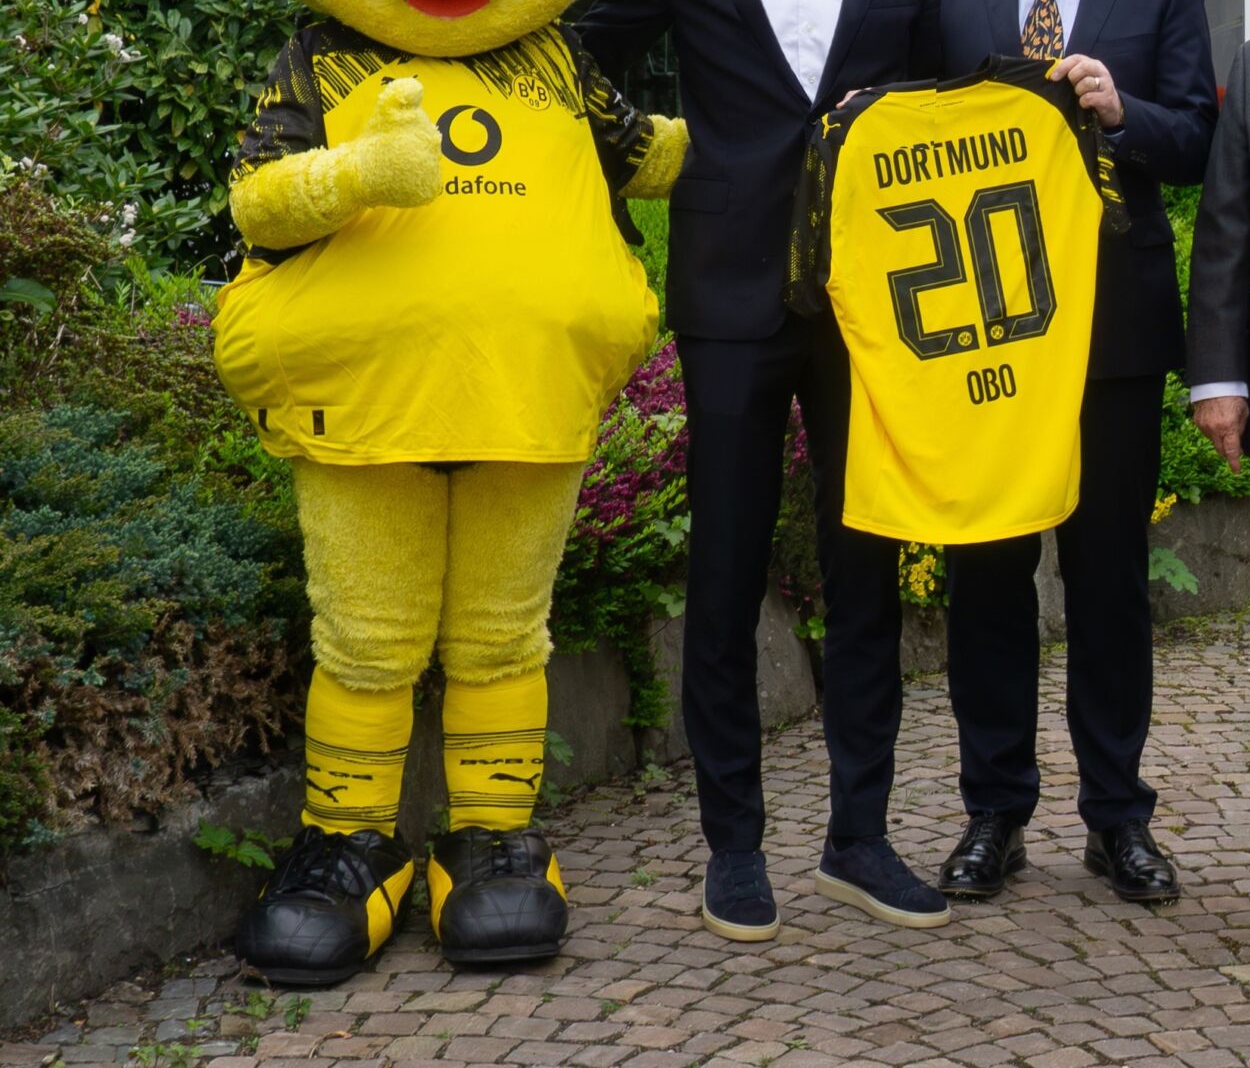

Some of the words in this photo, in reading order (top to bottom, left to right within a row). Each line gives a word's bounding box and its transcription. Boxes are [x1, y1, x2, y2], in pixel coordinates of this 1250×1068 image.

[517, 77, 548, 102] BVB
[528, 98, 540, 108] 09
[873, 127, 1028, 189] DORTMUND
[440, 175, 527, 197] dafone
[874, 179, 1058, 361] 20
[966, 363, 1018, 406] OBO
